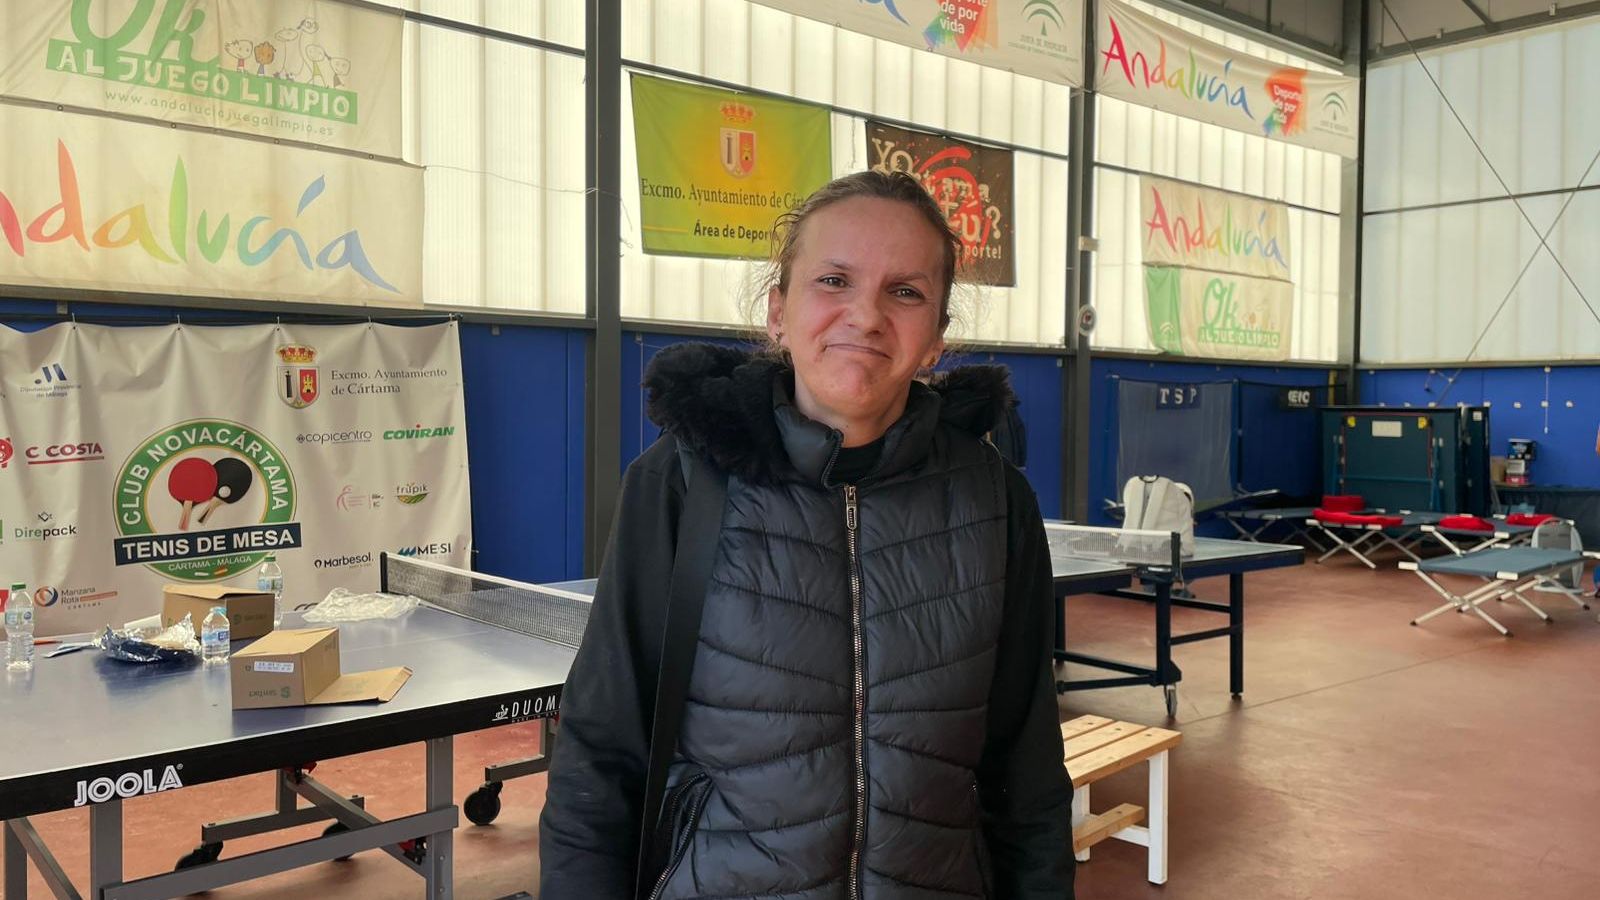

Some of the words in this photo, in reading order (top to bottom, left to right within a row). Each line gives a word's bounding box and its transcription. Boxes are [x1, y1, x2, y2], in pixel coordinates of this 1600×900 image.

[940, 1, 956, 14] de
[958, 7, 978, 20] por
[940, 17, 965, 33] vida
[1101, 15, 1254, 120] Andalucía
[56, 45, 104, 75] AL
[117, 57, 230, 96] JUEGO
[240, 76, 351, 117] LIMPIO
[641, 178, 686, 199] Excmo.
[689, 184, 767, 206] Ayuntamiento
[770, 191, 782, 207] de
[694, 218, 720, 237] Área
[722, 223, 735, 238] de
[738, 226, 768, 243] Depor
[1146, 185, 1288, 270] Andalucía
[331, 369, 371, 381] Excmo.
[374, 368, 447, 381] Ayuntamiento
[331, 385, 345, 396] de
[347, 382, 401, 395] Cártama
[305, 430, 372, 444] copicentro
[25, 446, 39, 459] C
[45, 442, 103, 456] COSTA
[123, 464, 149, 525] CLUB
[15, 525, 77, 540] Direpack
[122, 540, 190, 560] TENIS
[197, 535, 226, 553] DE
[233, 528, 294, 549] MESA
[61, 587, 96, 596] Manzana
[511, 694, 561, 718] DUOM
